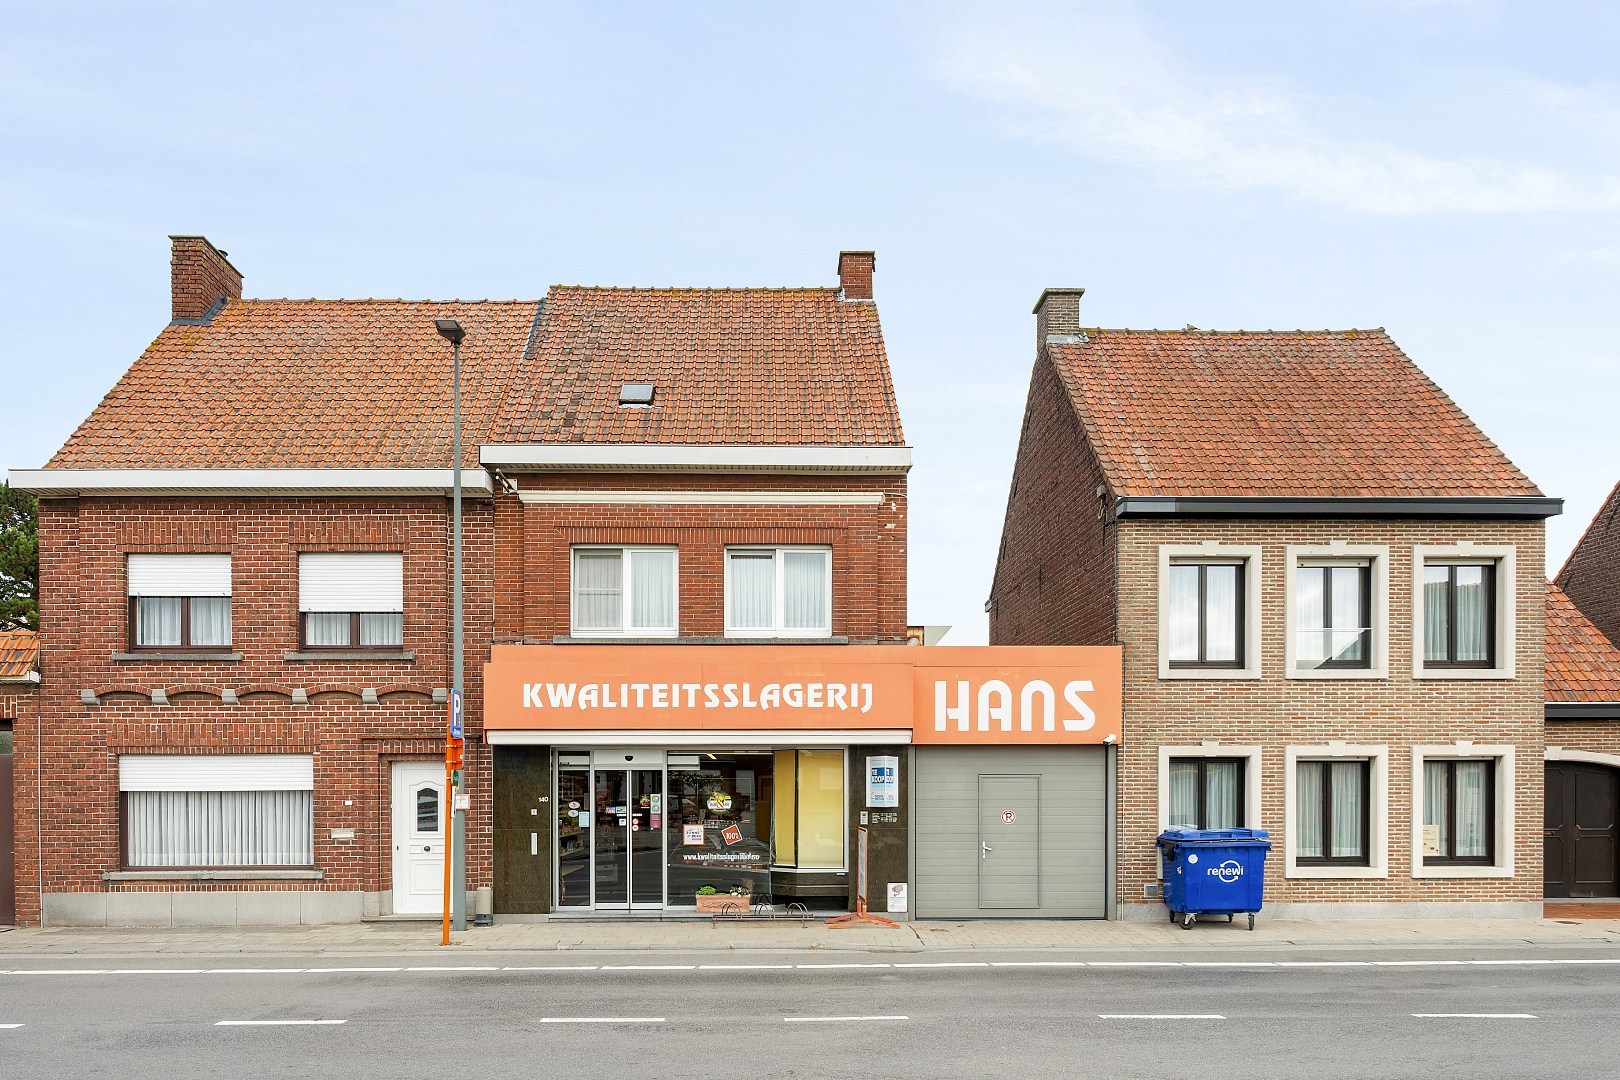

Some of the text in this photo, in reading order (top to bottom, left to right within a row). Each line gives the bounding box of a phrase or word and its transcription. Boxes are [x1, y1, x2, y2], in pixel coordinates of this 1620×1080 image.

[454, 694, 461, 726] P
[523, 683, 873, 714] KWALITEITSSLAGERIJ
[934, 679, 1096, 732] HANS
[1207, 865, 1244, 876] renewi
